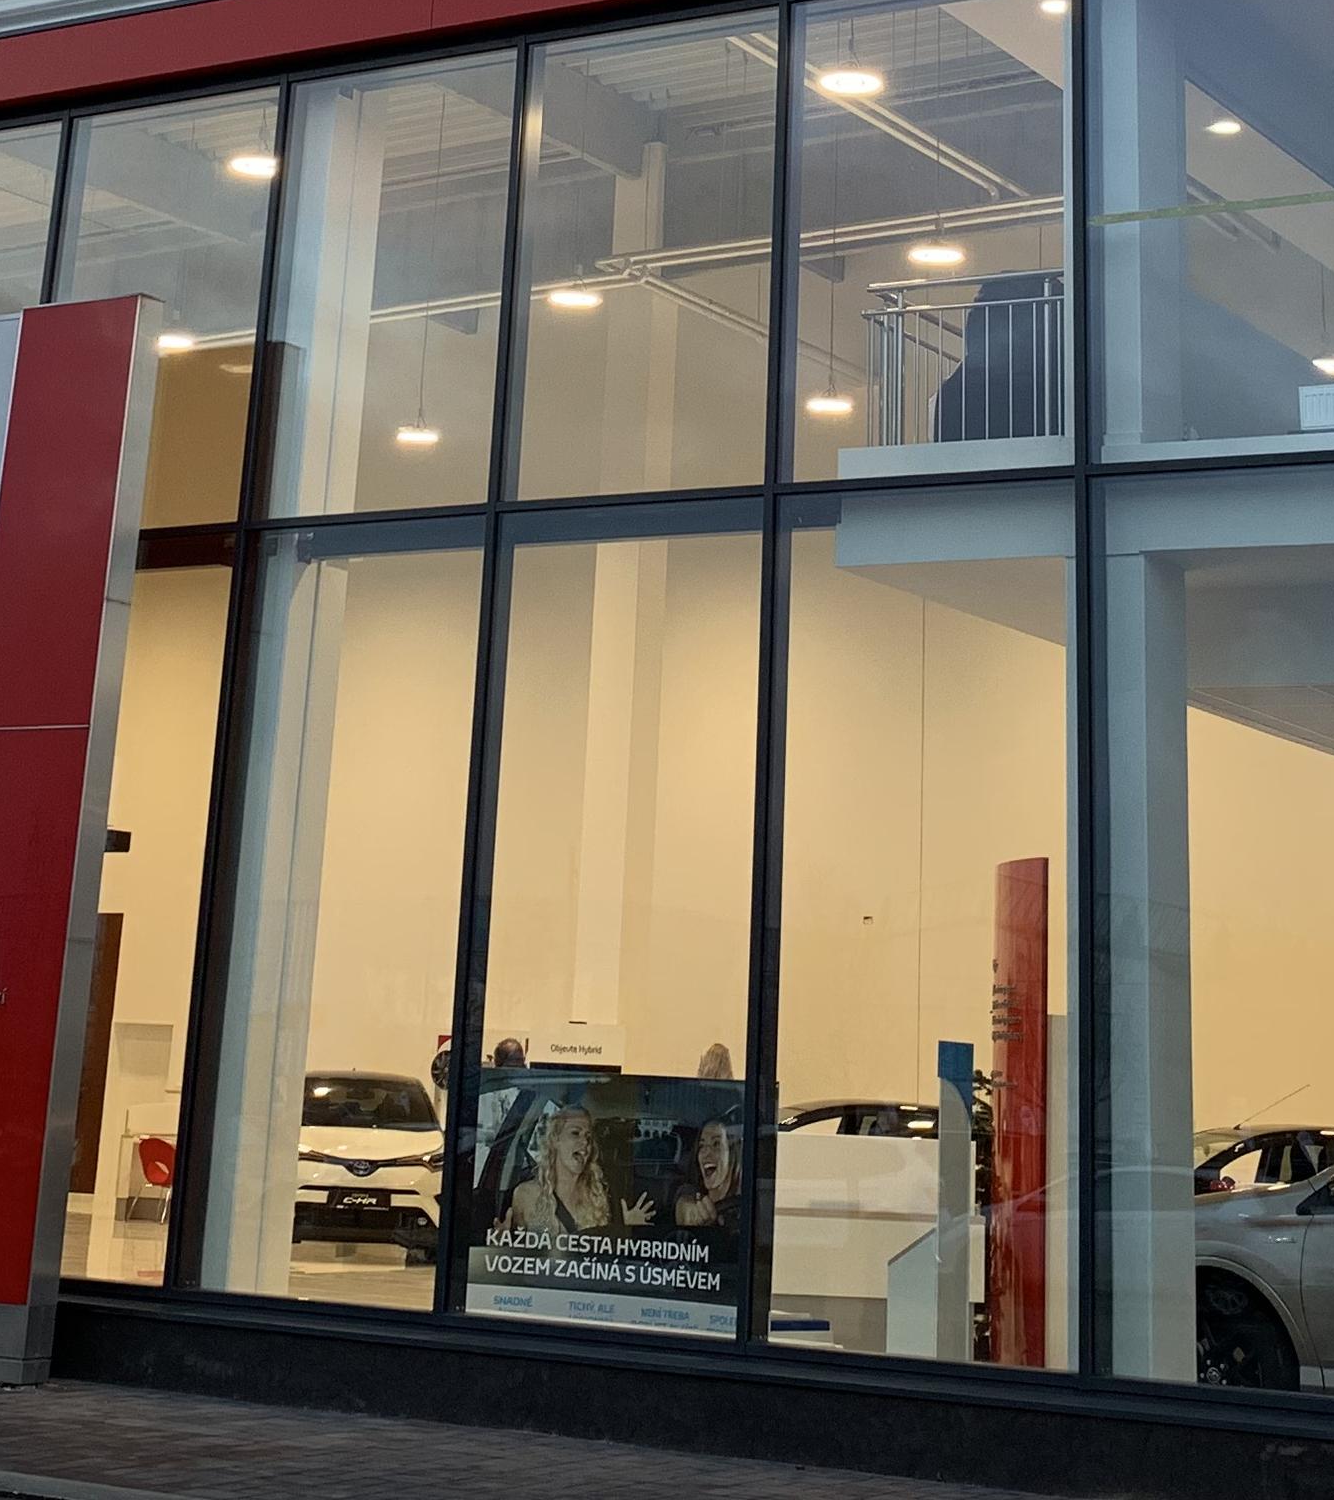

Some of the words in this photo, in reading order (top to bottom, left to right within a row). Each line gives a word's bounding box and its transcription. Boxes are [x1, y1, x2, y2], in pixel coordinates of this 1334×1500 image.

[343, 1196, 377, 1205] C-HR
[486, 1227, 552, 1250] KAŽDÁ
[555, 1234, 612, 1254] CESTA
[616, 1238, 709, 1263] HYBRIDNÍM
[484, 1255, 550, 1276] VOZEM
[554, 1257, 621, 1282] ZAČÍNÁ
[624, 1266, 636, 1283] S
[639, 1263, 721, 1291] ÚSMĚVEM
